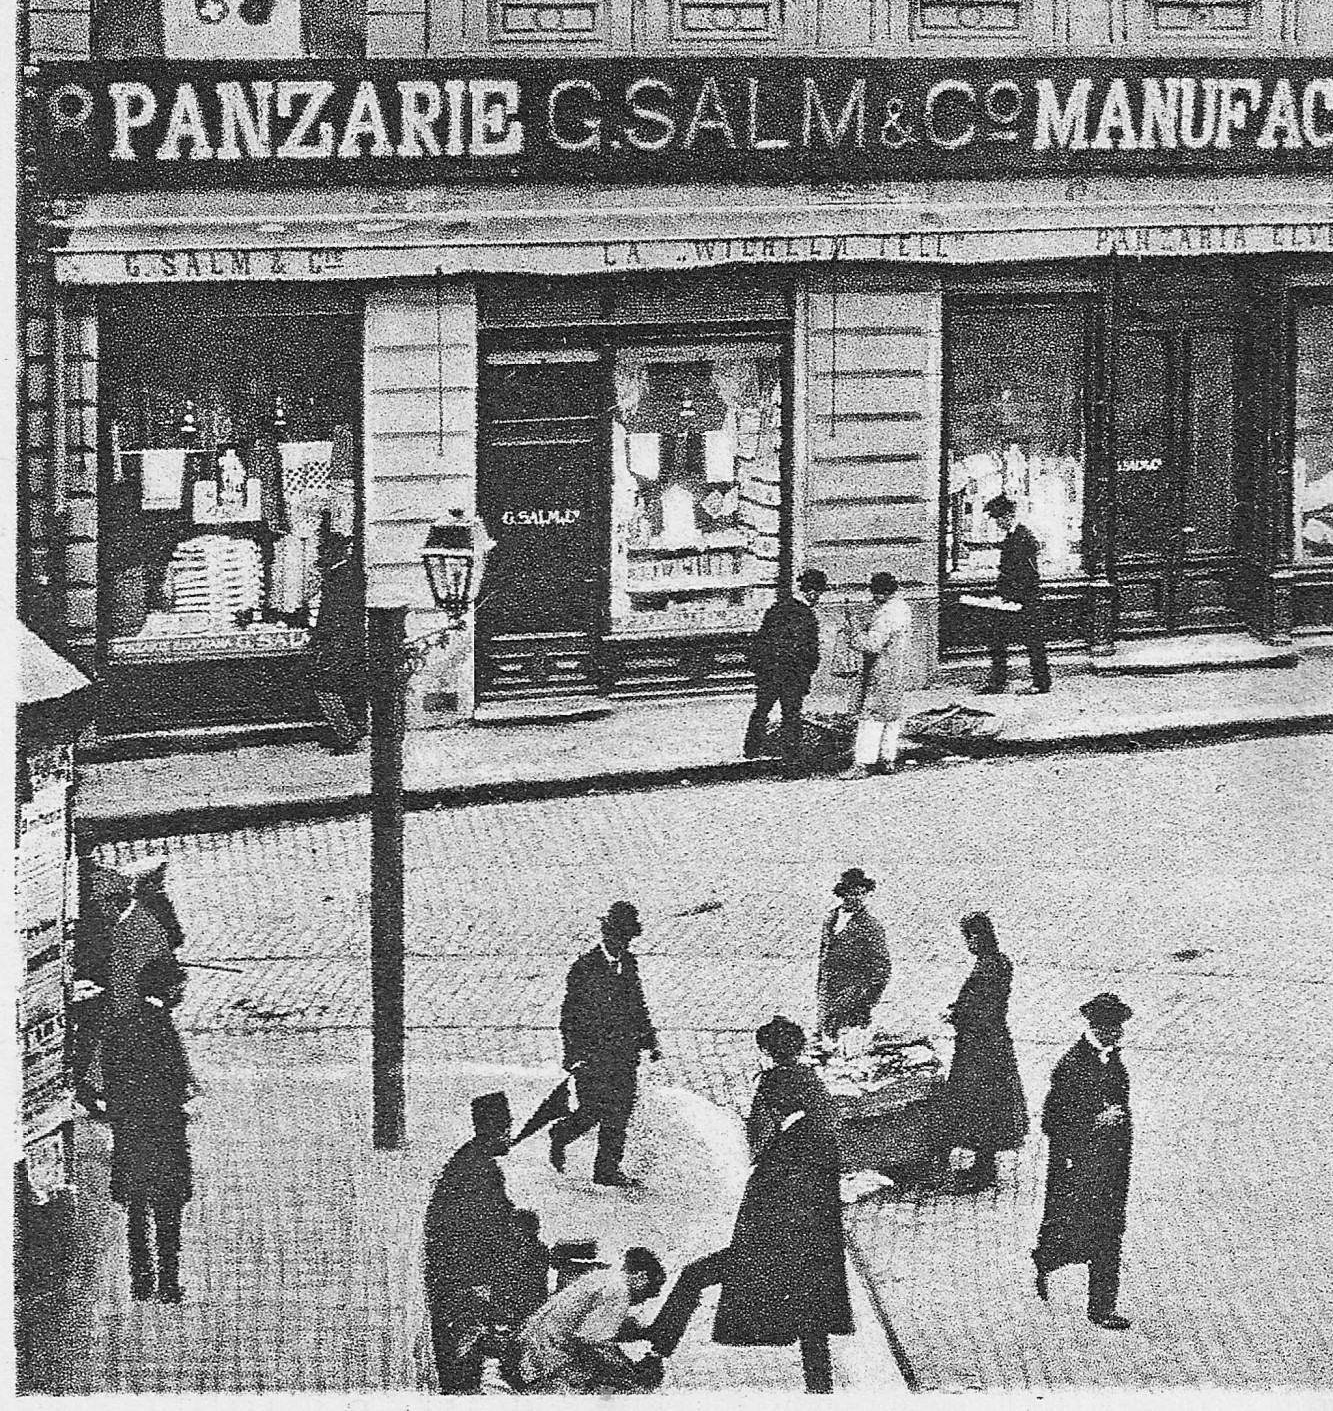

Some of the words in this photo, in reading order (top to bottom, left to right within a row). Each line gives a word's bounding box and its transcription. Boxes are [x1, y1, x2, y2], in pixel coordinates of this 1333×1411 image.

[107, 79, 524, 161] PANZARIE
[161, 248, 251, 277] SALM
[602, 241, 640, 267] LA
